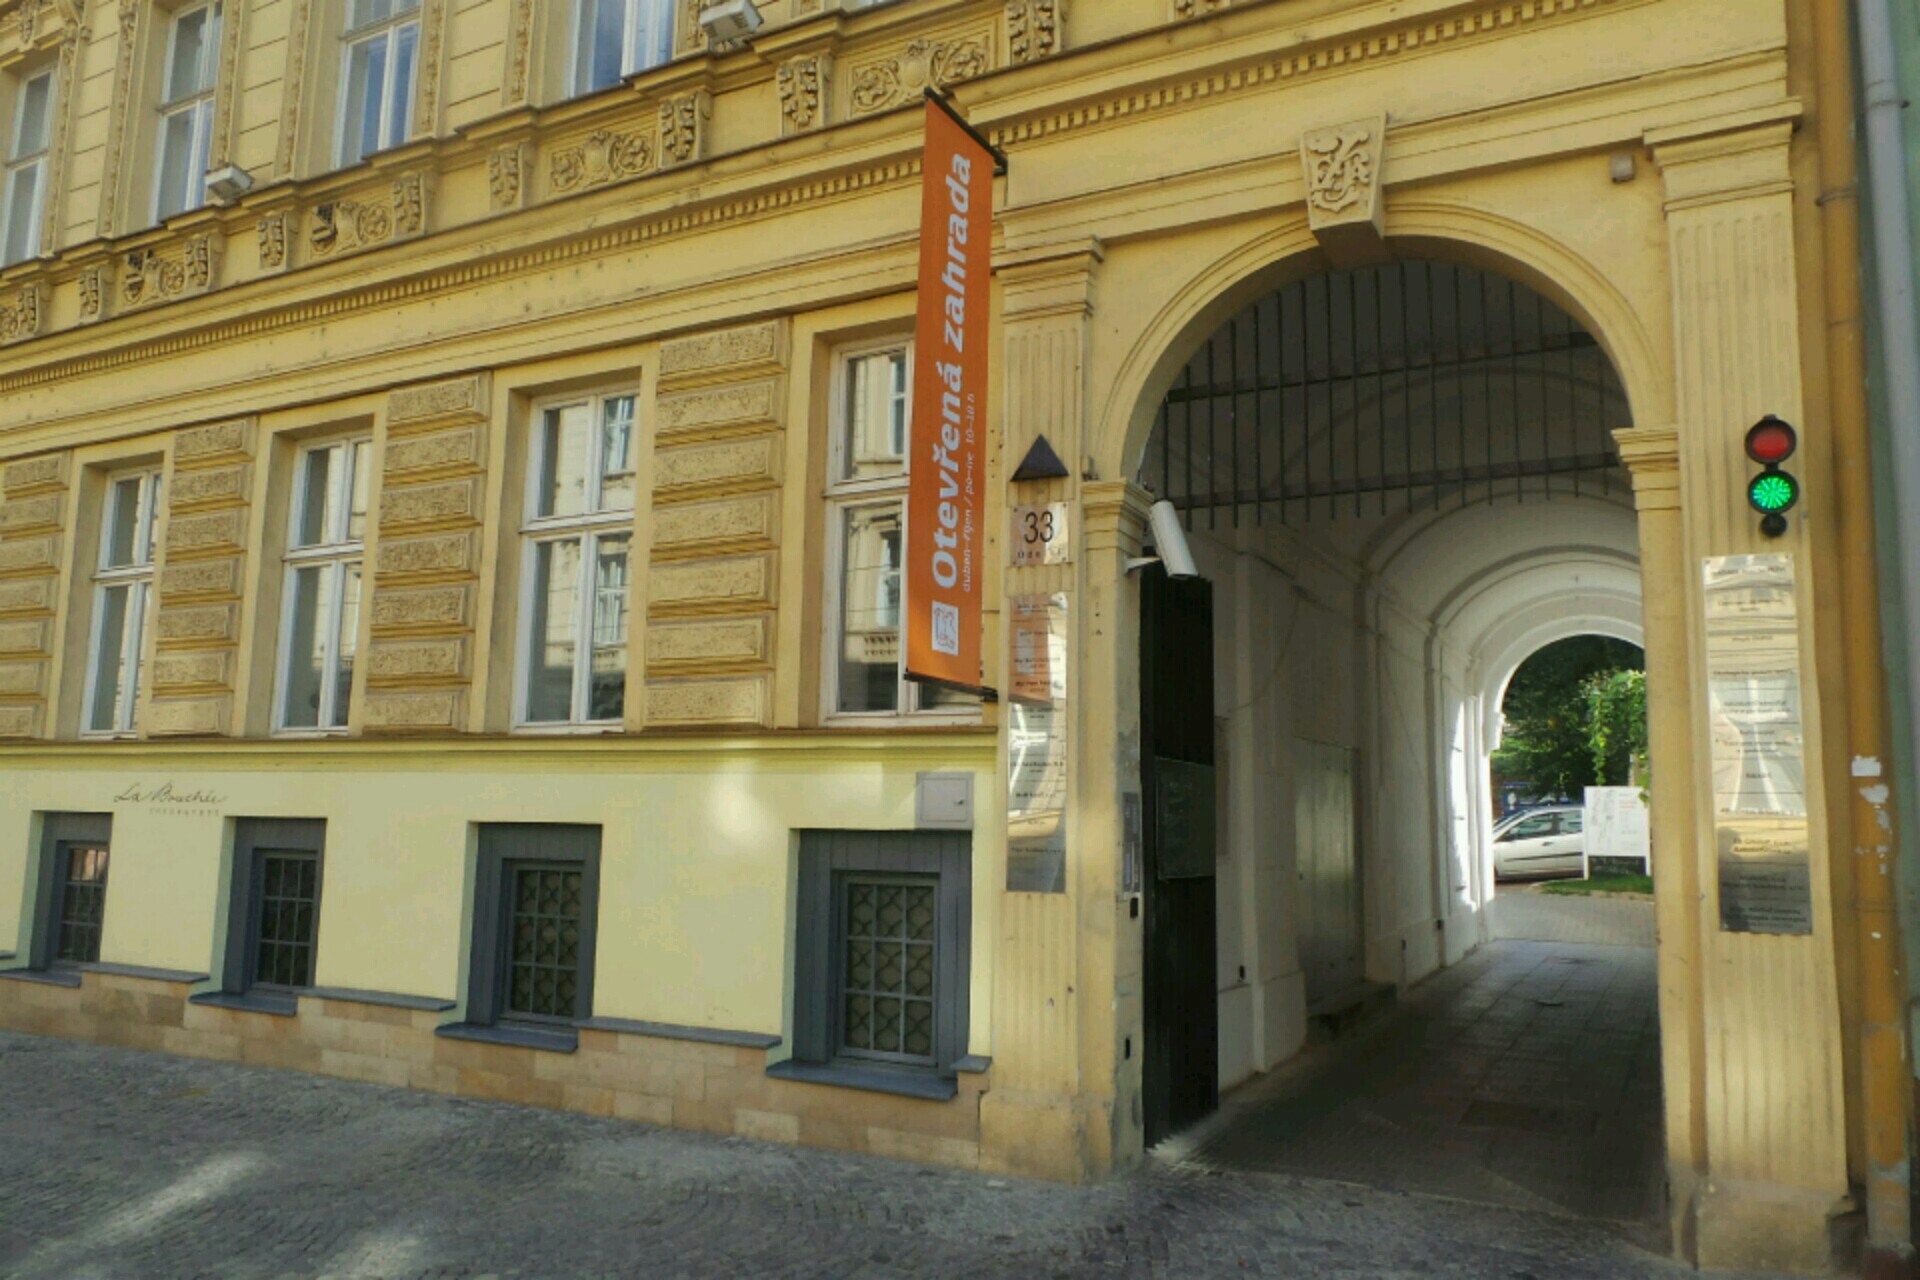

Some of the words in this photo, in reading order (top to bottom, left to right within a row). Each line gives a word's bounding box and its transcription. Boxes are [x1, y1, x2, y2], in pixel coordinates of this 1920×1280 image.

[942, 153, 970, 353] zahrada
[932, 360, 963, 588] Otevřená
[1023, 510, 1054, 544] 33
[113, 782, 142, 803] La
